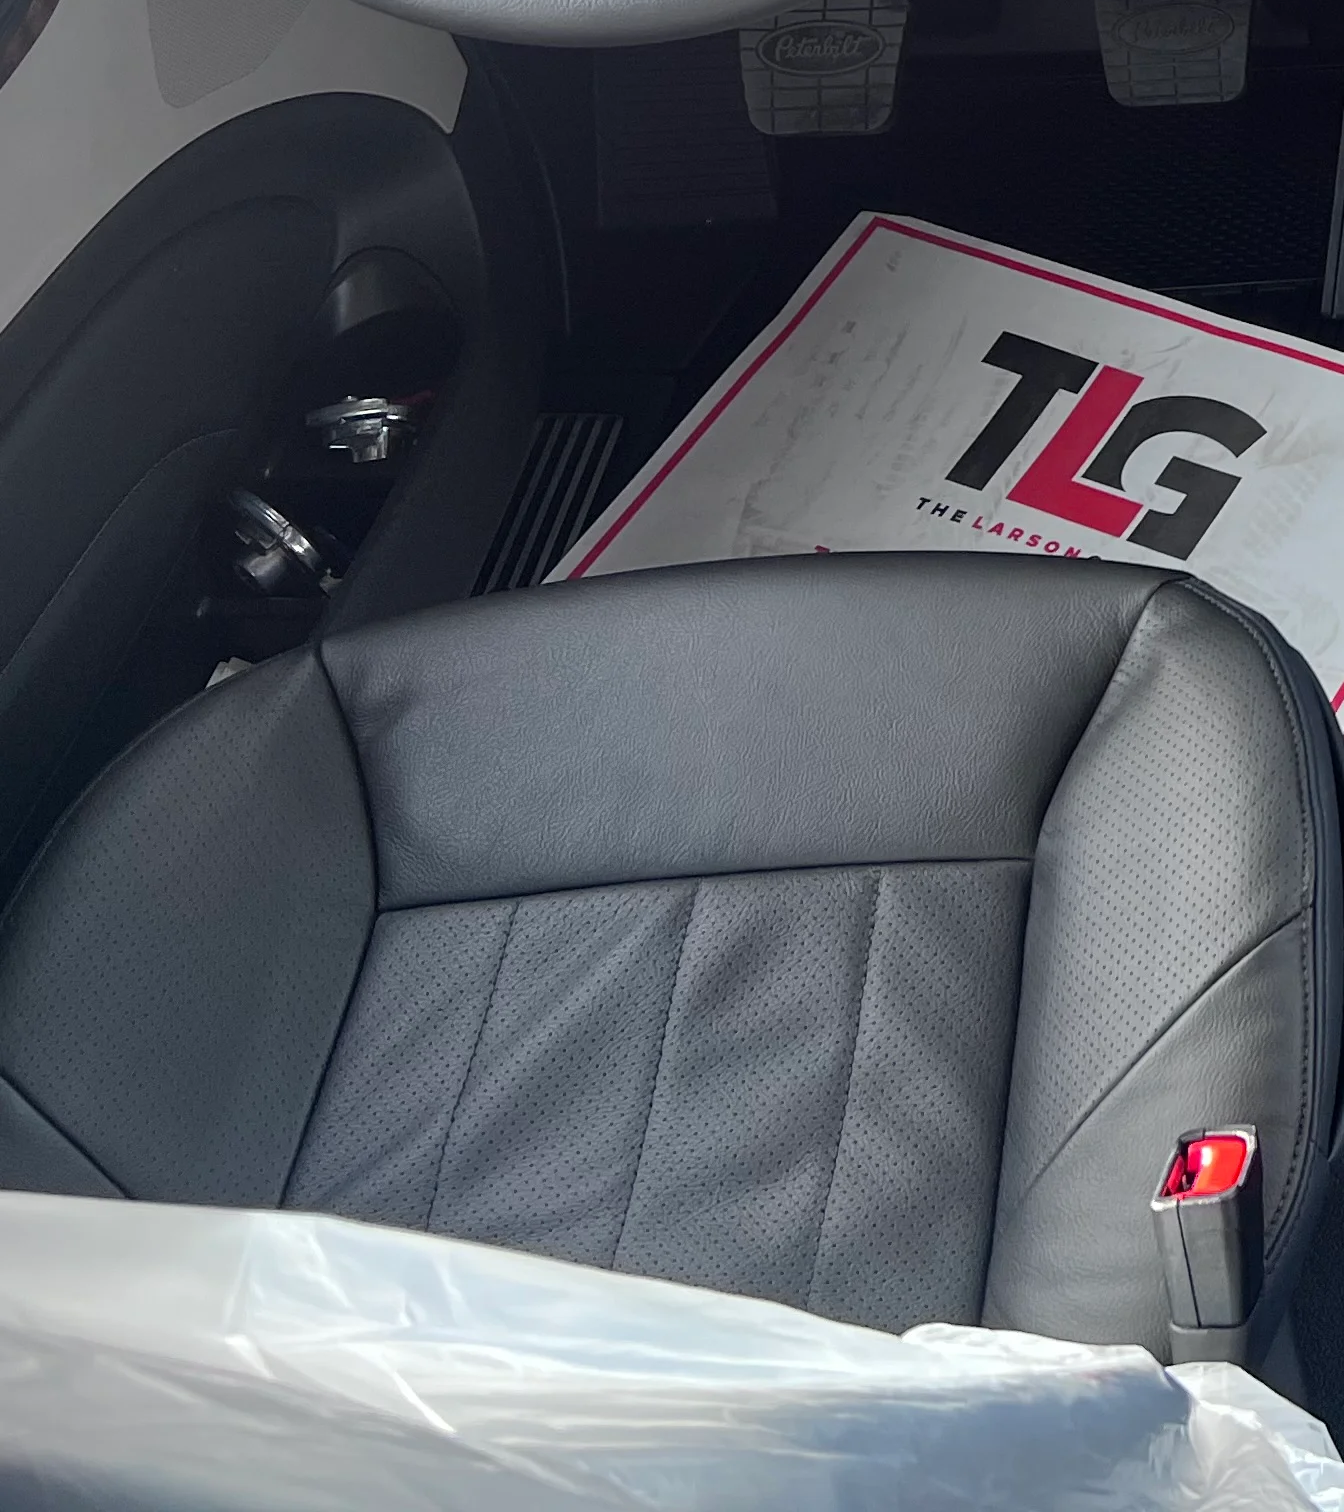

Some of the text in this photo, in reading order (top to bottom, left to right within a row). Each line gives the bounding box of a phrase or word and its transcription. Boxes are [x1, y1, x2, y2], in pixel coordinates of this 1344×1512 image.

[774, 34, 872, 62] Peterbilt
[945, 330, 1268, 562] TLG
[917, 496, 1083, 560] THE LARSON
